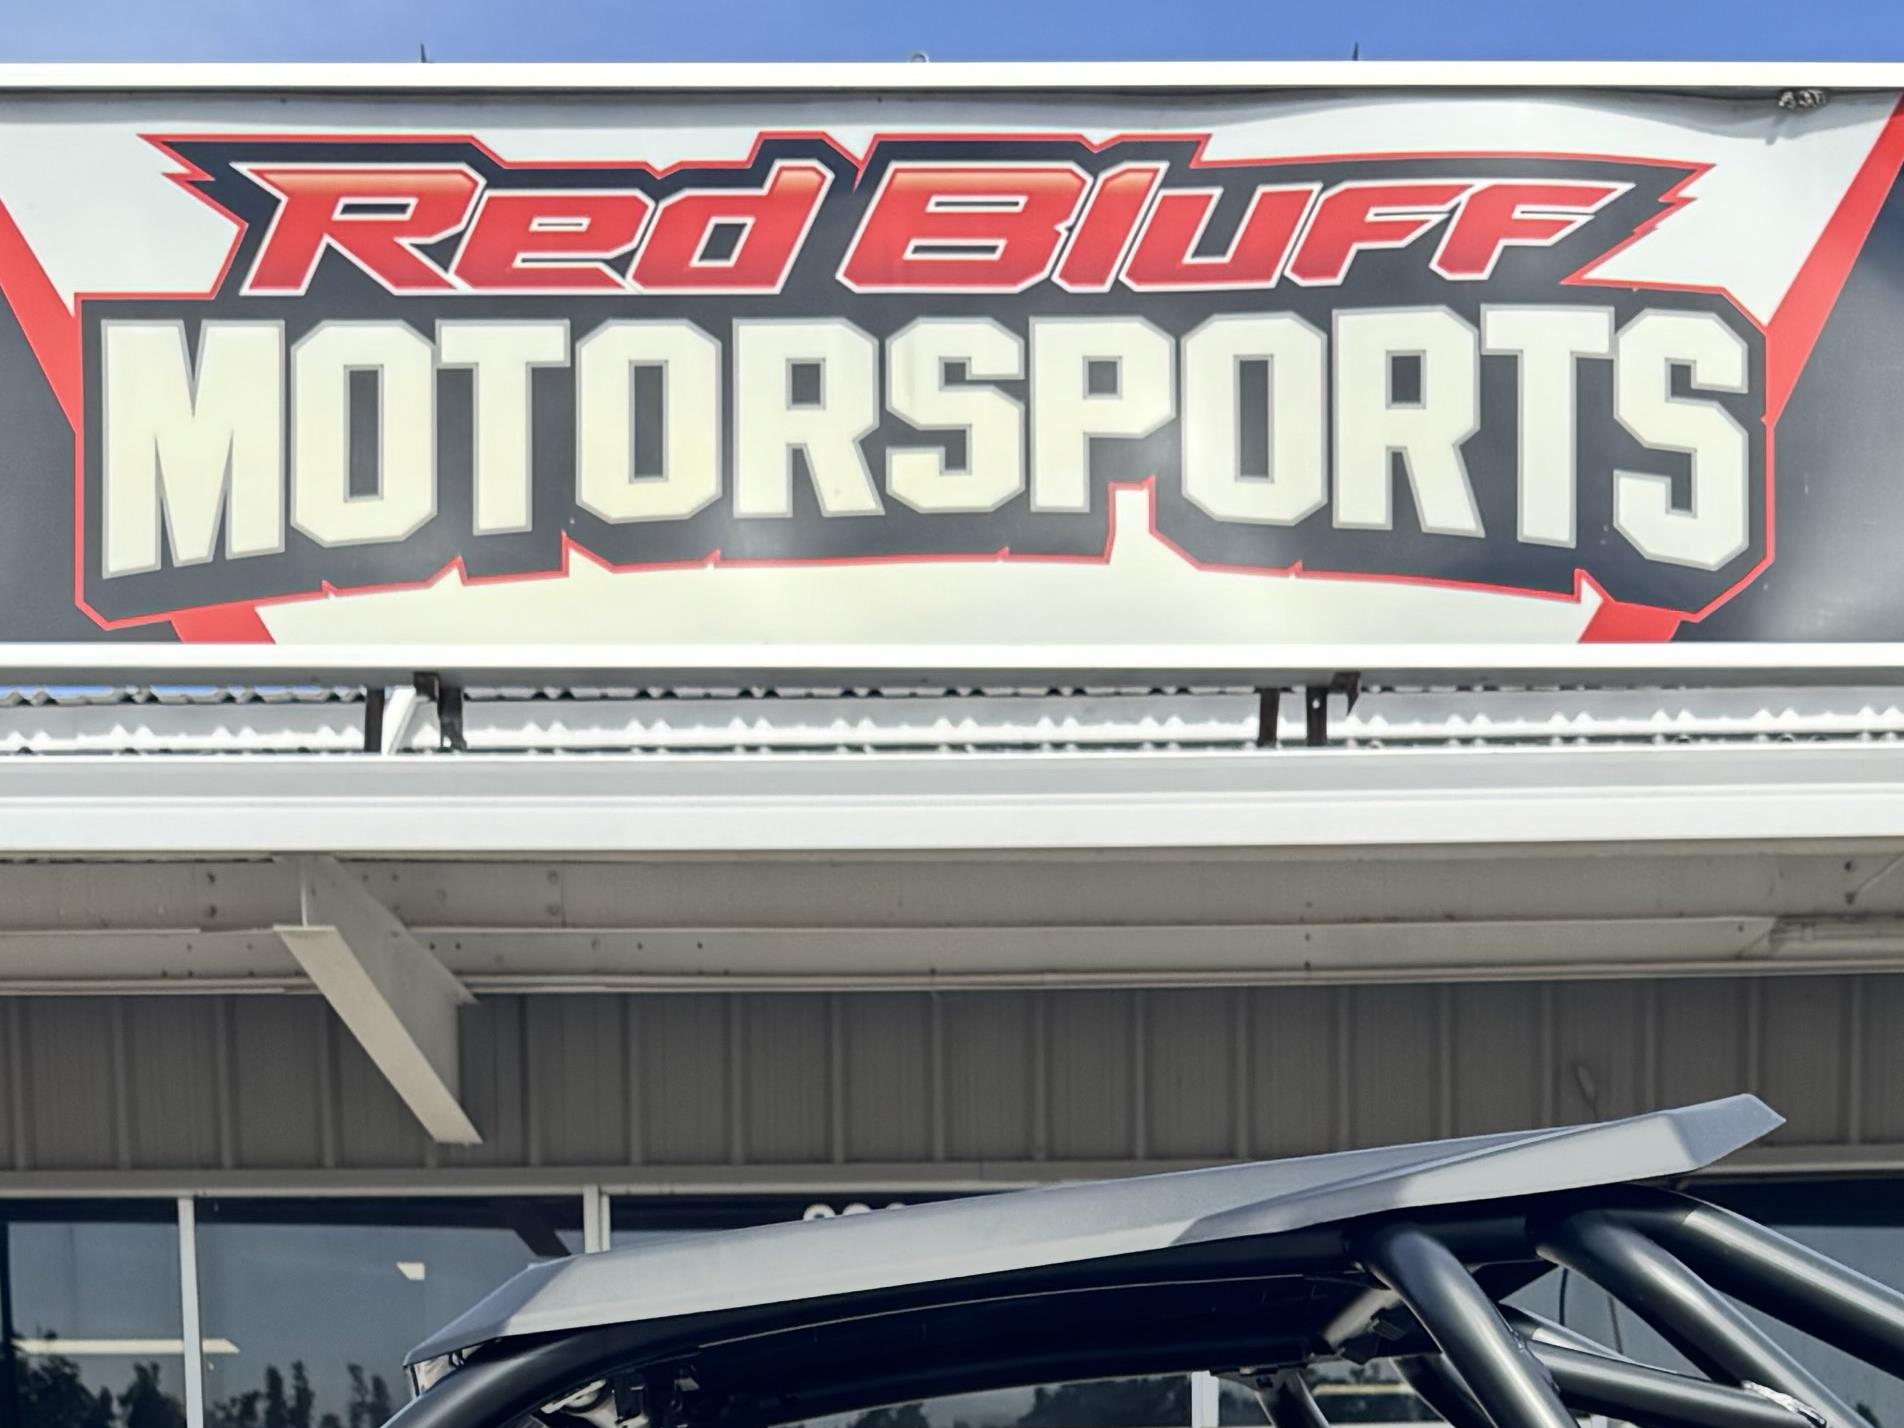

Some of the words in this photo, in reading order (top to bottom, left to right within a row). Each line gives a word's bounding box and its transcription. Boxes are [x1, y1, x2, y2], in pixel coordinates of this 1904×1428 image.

[241, 160, 827, 295] Red
[836, 158, 1633, 293] Bluff
[102, 305, 1751, 575] MOTORSPORTS
